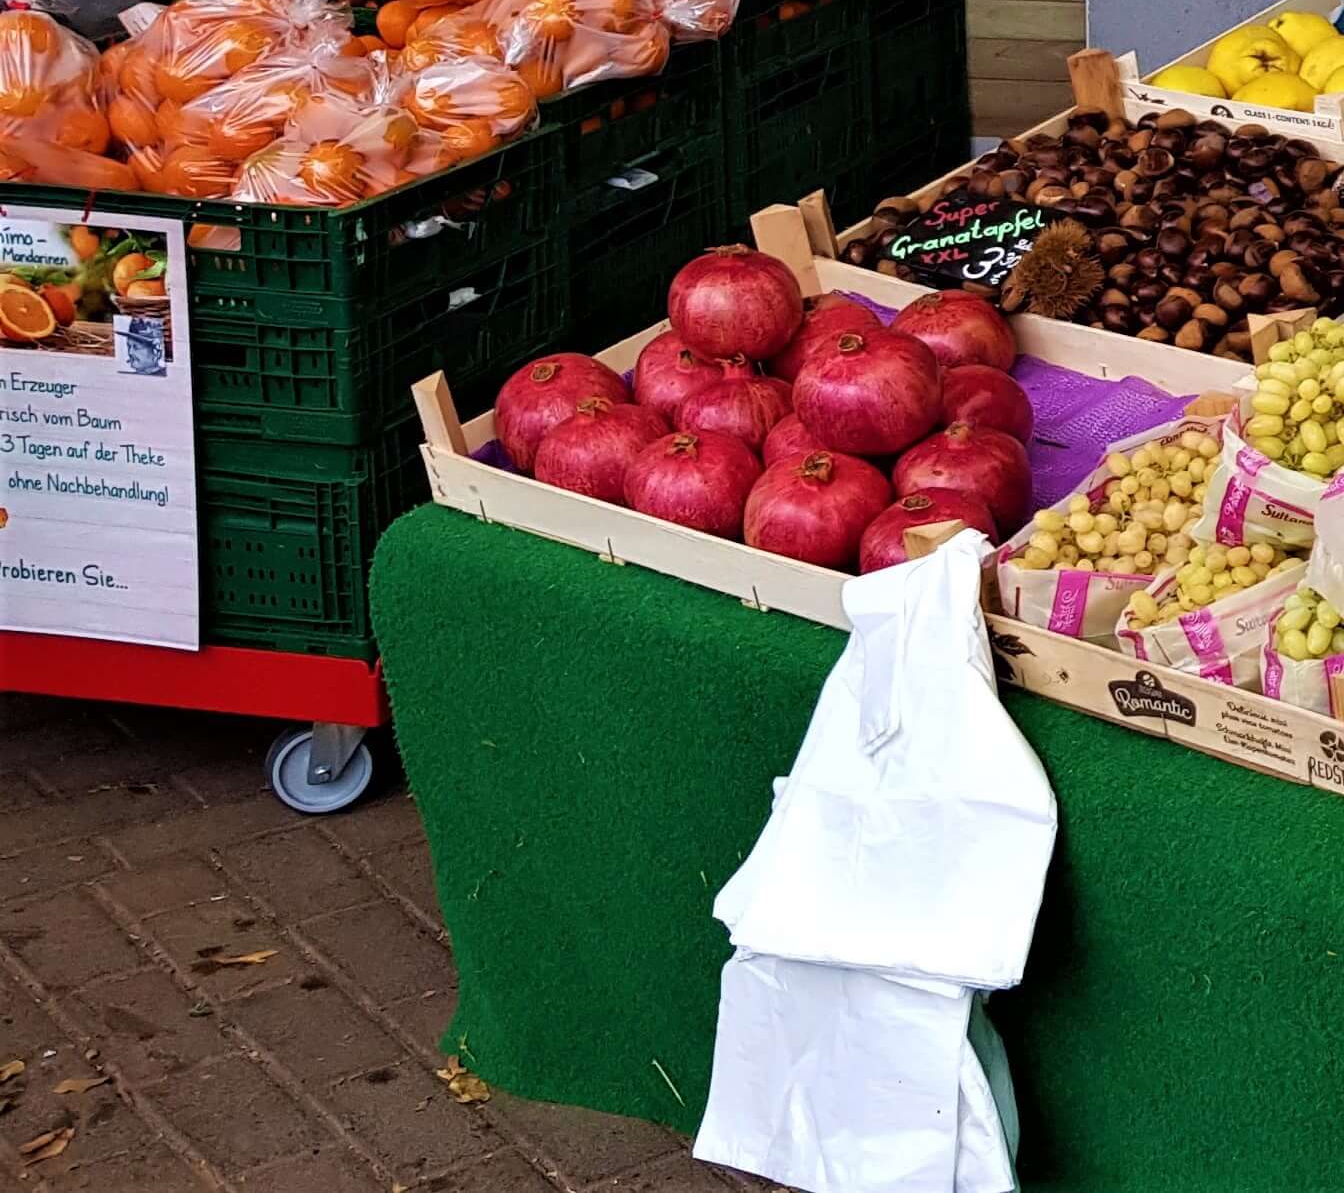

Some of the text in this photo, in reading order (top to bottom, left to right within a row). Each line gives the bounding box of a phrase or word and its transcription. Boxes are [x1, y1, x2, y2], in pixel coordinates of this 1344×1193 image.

[925, 201, 1000, 227] Super
[0, 227, 33, 246] nimo
[891, 208, 1046, 260] Granatapfel
[2, 247, 69, 265] Mandarinen
[921, 248, 969, 264] XXL
[11, 372, 78, 398] Erzeuger
[0, 404, 122, 431] risch vom Baum
[16, 435, 62, 460] Tagen
[67, 441, 90, 459] auf
[95, 442, 118, 462] der
[120, 444, 166, 467] Theke
[8, 471, 169, 507] ohne Nachbehandlung!
[0, 559, 76, 584] robieren
[1115, 687, 1192, 719] Romantic
